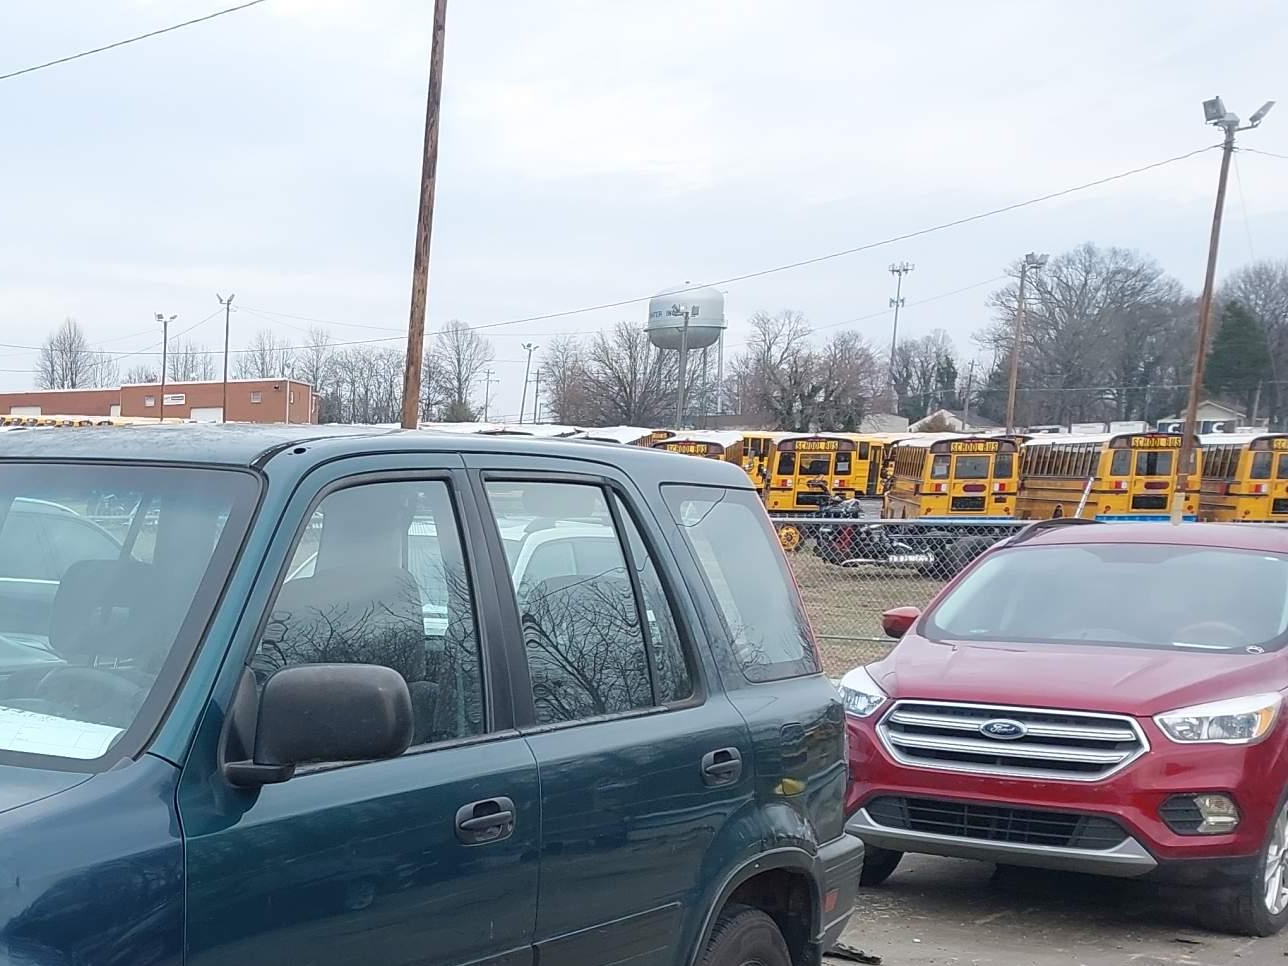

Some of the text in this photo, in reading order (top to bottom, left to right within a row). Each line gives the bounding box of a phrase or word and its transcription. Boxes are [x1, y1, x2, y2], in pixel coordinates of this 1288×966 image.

[796, 441, 839, 450] SCHOOL BUS
[951, 442, 998, 452] SCHOOL BUS
[1133, 437, 1181, 447] SCHOOL BUS
